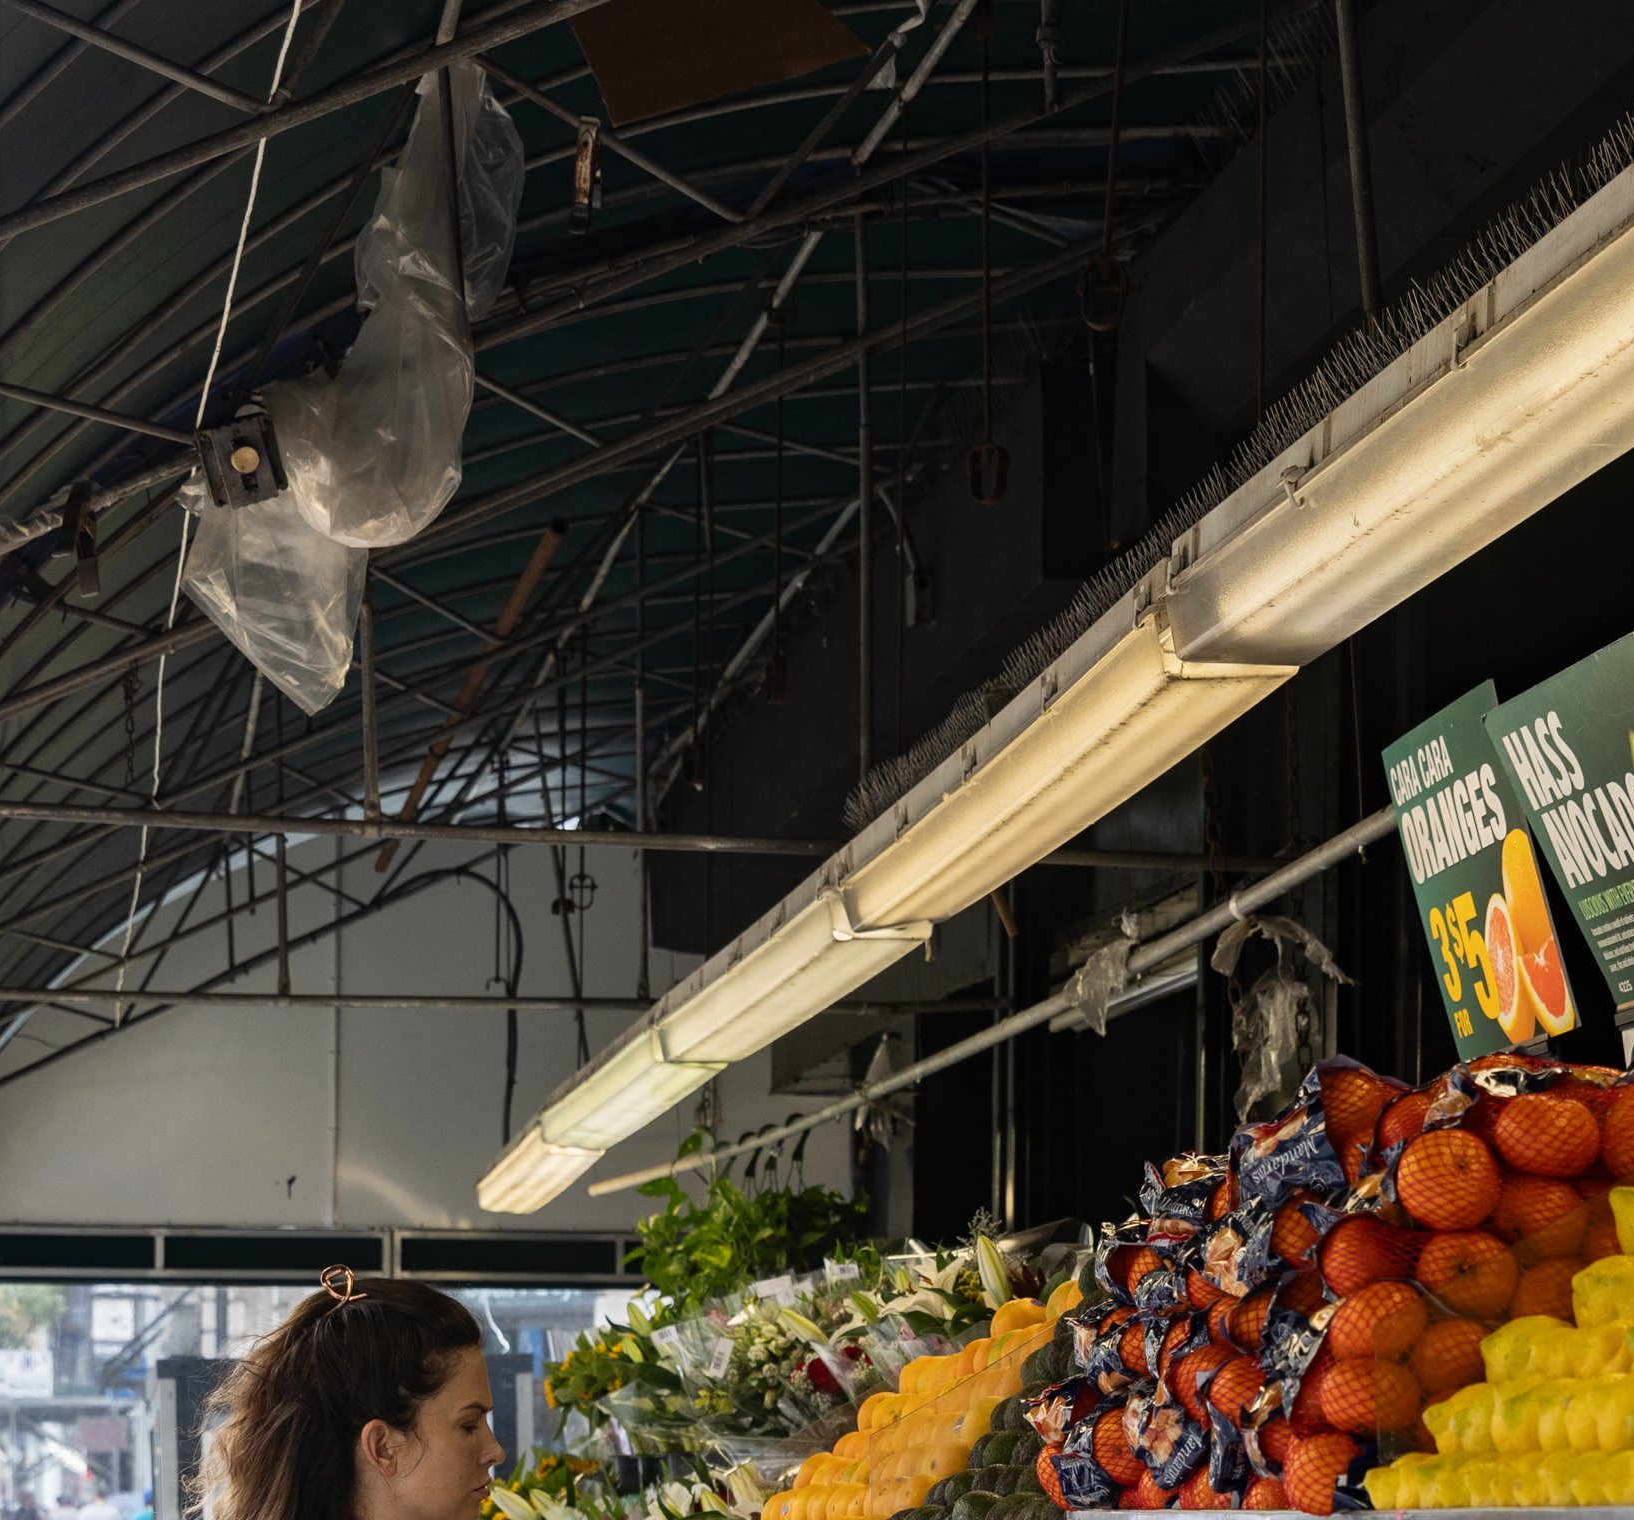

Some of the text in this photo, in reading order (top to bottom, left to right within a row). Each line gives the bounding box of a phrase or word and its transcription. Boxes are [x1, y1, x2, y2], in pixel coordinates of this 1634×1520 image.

[1389, 734, 1454, 806] CARA CARA
[1501, 710, 1586, 811] HASS
[1401, 763, 1508, 885] ORANGES
[1453, 1006, 1474, 1040] FOR
